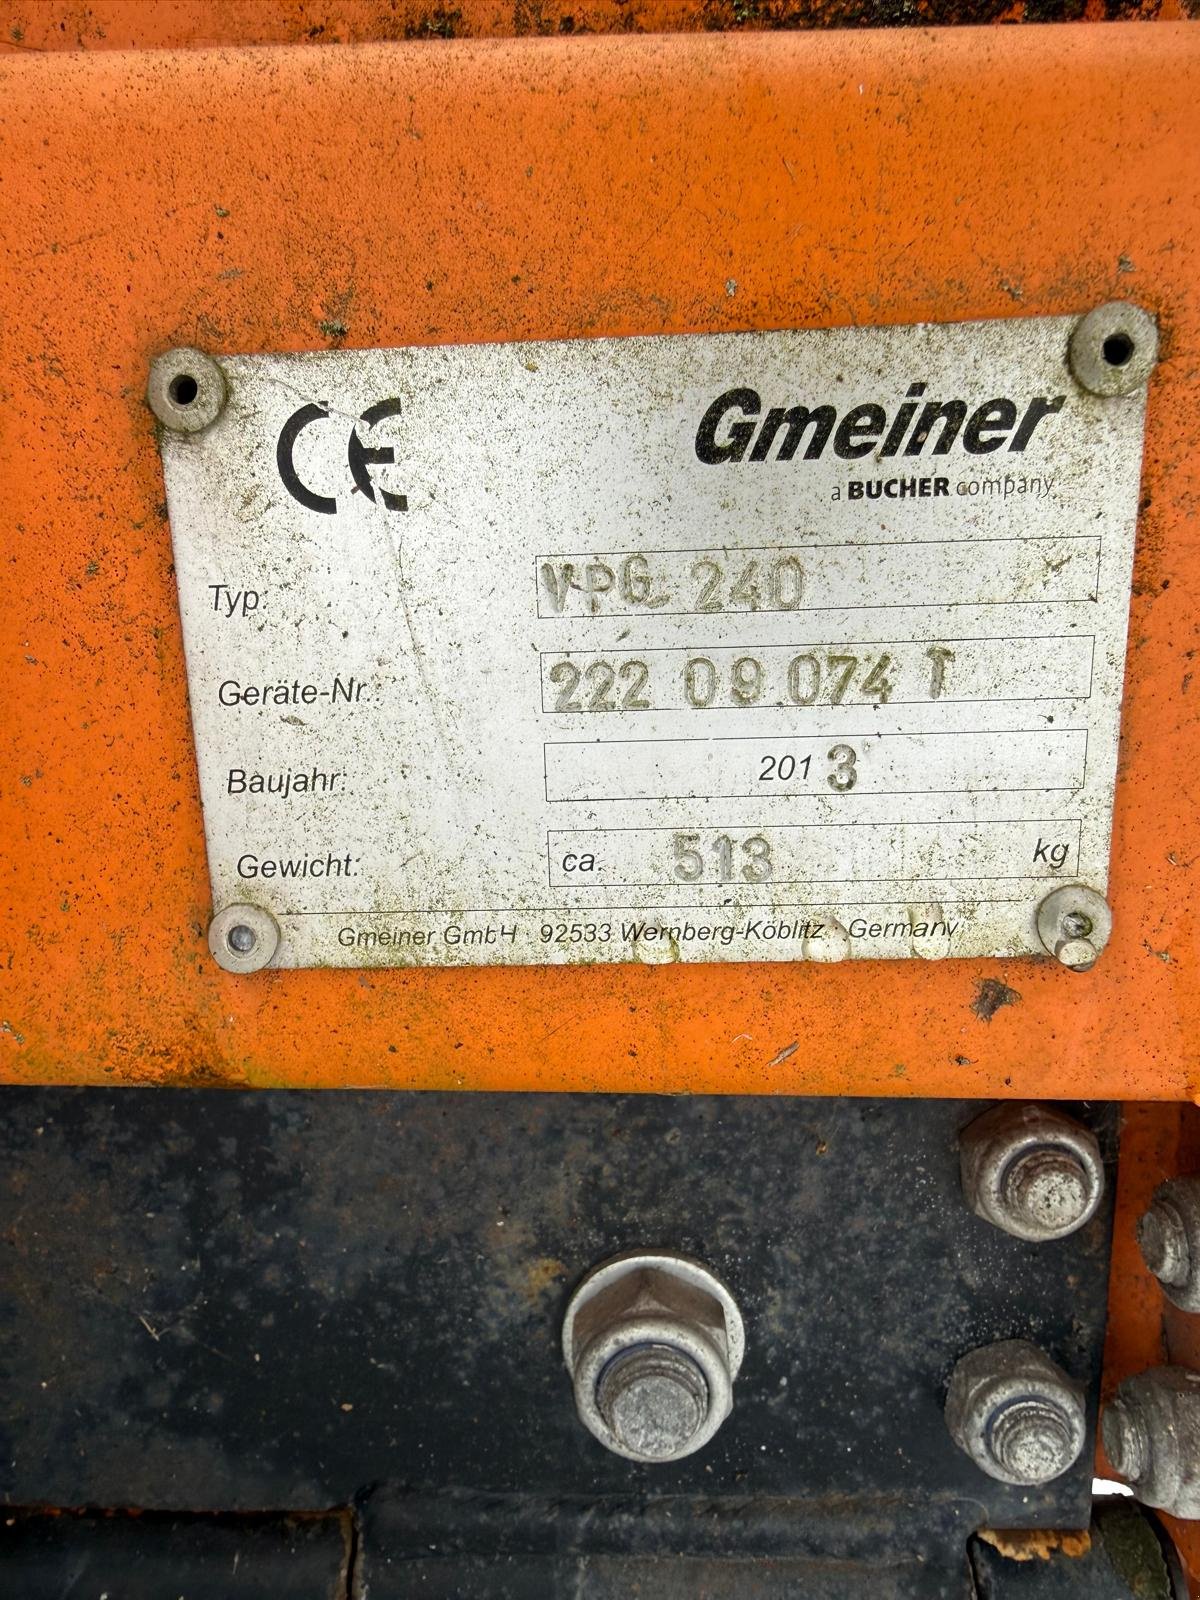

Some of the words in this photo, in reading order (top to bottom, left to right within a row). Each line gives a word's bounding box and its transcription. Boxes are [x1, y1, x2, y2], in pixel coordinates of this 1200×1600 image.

[695, 382, 1067, 465] Gmeiner
[277, 398, 409, 514] CE
[831, 486, 842, 501] a
[847, 477, 950, 500] BUCHER
[956, 475, 1055, 500] company
[208, 584, 269, 618] Typ:
[690, 556, 806, 613] 240
[549, 659, 650, 712] 222
[786, 652, 894, 706] 074
[227, 767, 348, 799] Baujahr:
[236, 853, 361, 879] Gewicht:
[672, 832, 773, 884] 513
[1033, 838, 1069, 867] kg
[338, 925, 436, 947] Gmeiner
[443, 923, 518, 946] GmbH
[540, 922, 612, 944] 92533
